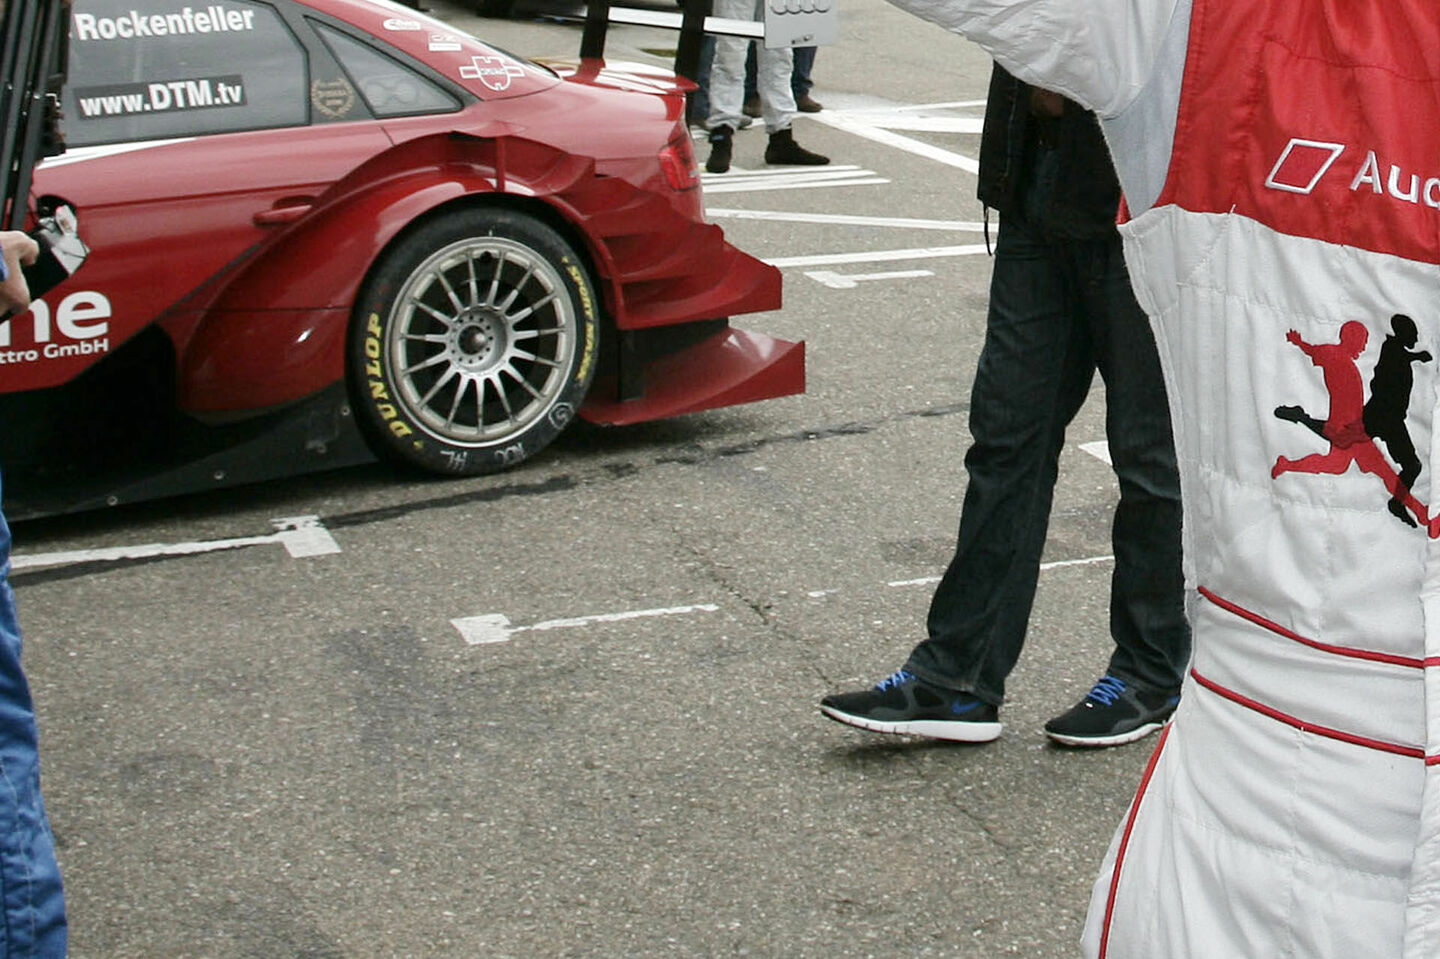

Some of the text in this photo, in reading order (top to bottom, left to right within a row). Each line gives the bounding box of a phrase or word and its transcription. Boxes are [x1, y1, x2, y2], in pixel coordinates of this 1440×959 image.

[74, 6, 254, 41] Rockenfeller
[80, 80, 242, 116] www.DTM.tv
[43, 338, 109, 358] GmbH
[365, 312, 412, 438] DUNLOP
